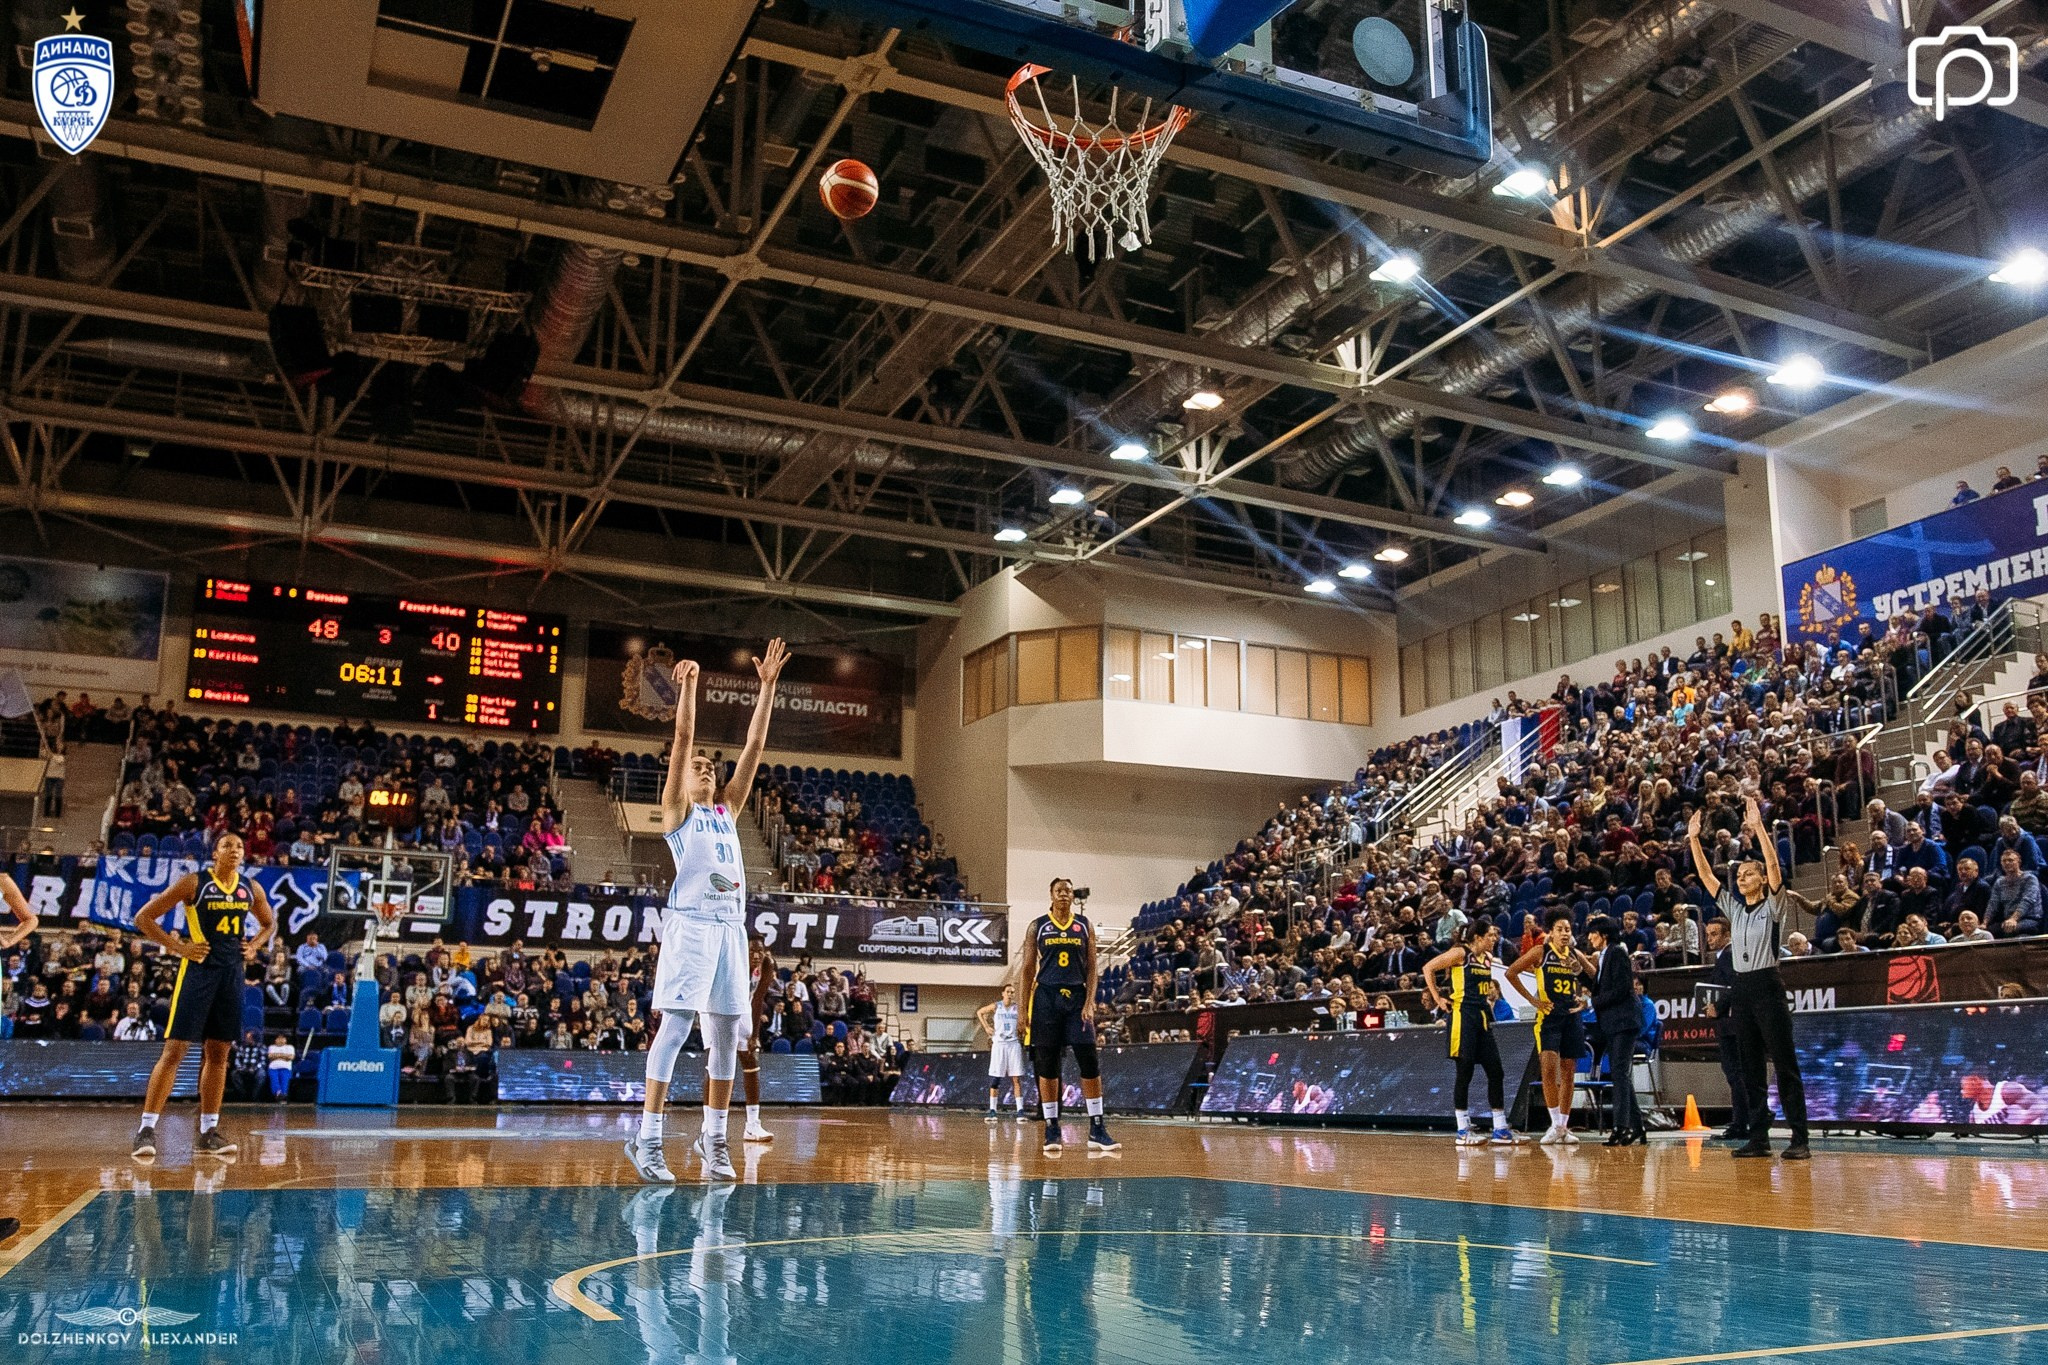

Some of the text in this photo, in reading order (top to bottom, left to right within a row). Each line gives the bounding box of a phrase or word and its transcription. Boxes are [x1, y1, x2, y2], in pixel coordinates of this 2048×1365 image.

[399, 600, 467, 617] Fenerbahce
[308, 619, 339, 639] 48
[379, 628, 392, 645] 3
[431, 632, 461, 651] 40
[340, 663, 402, 687] 06:11
[706, 677, 812, 696] АДМИНИРАЦИЯ
[428, 704, 437, 719] 1
[706, 689, 868, 717] КУРСКЙ ОБЛАСТИ
[715, 842, 734, 864] 30
[216, 915, 240, 935] 41
[483, 899, 838, 949] STRONST!
[858, 944, 1002, 958] СПОРТИВНО-КОНЦЕРТНЫЙ КОМПЛЕКС
[1058, 951, 1069, 967] 8
[1553, 978, 1571, 995] 32
[1683, 1027, 1716, 1039] КОМА
[337, 1060, 385, 1072] molten
